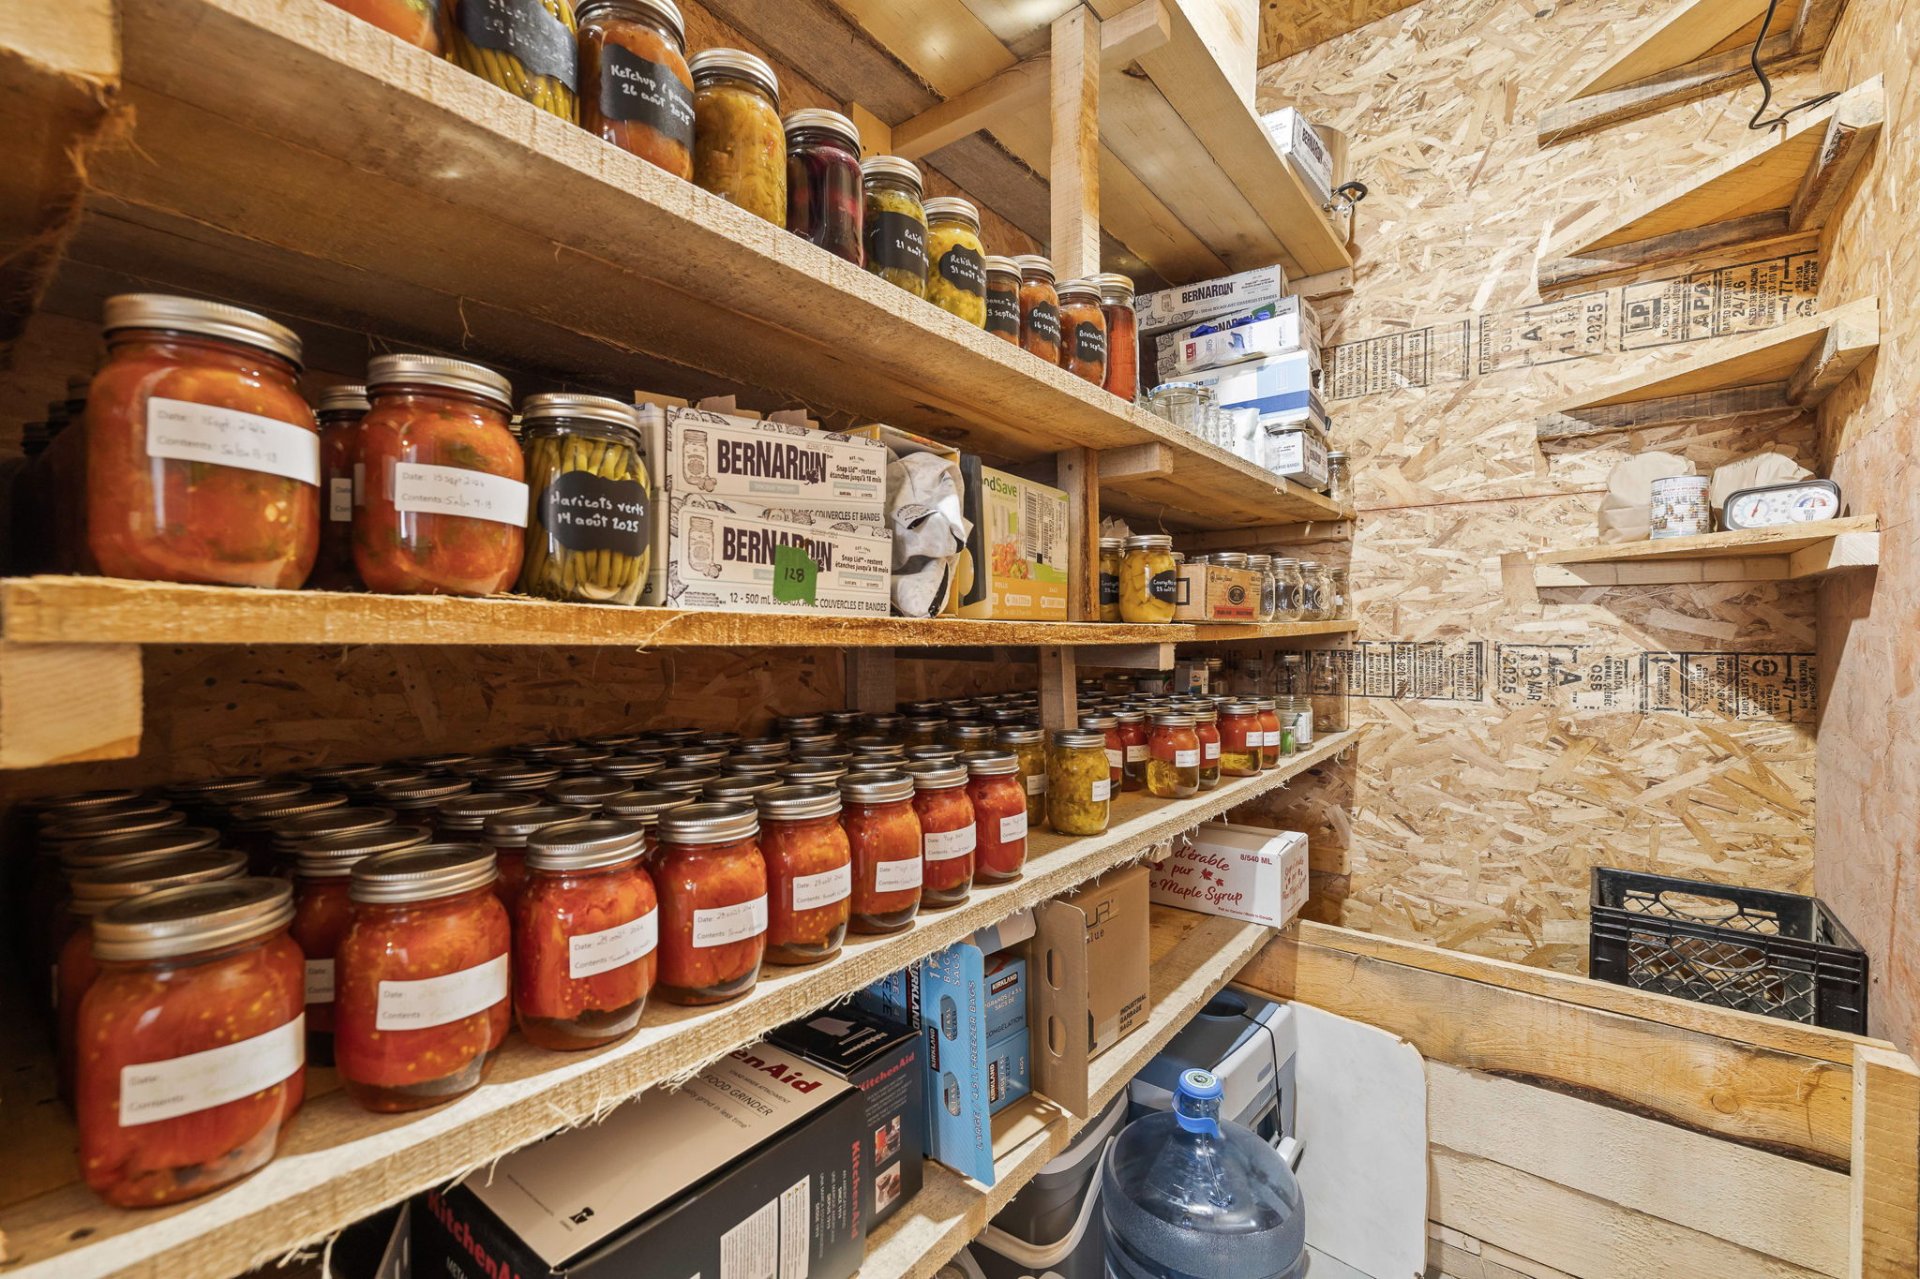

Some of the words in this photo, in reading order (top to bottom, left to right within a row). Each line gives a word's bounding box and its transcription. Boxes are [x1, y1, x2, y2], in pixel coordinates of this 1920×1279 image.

[610, 65, 656, 91] Ketchup
[1182, 282, 1233, 303] BERNARDIN
[1732, 281, 1748, 318] 24/16
[1630, 304, 1650, 329] LP
[1521, 326, 1542, 341] A
[717, 439, 828, 483] BERNARDIN
[550, 489, 613, 511] Haricots
[617, 493, 645, 515] verts
[556, 512, 571, 523] 14
[575, 512, 608, 529] août
[612, 514, 641, 533] 2025
[860, 512, 881, 522] BANDES
[784, 566, 806, 583] 128
[730, 593, 738, 604] 12
[745, 594, 759, 605] 500
[820, 599, 856, 610] COUVERCLES
[857, 601, 864, 610] ET
[864, 601, 887, 612] BANDES
[1502, 656, 1517, 694] 2025
[1559, 670, 1582, 686] A
[1590, 665, 1602, 691] OSB
[1783, 677, 1797, 700] 477
[1171, 862, 1196, 877] pur
[1174, 845, 1231, 871] d'érable
[1240, 853, 1259, 864] 8/540
[1260, 856, 1273, 866] ML
[1160, 878, 1203, 898] Maple
[1204, 887, 1243, 906] Syrup
[969, 1017, 977, 1069] FREEZER
[702, 1073, 731, 1091] FOOD
[730, 1088, 774, 1117] GRINDER
[851, 1140, 861, 1239] KitchenAid
